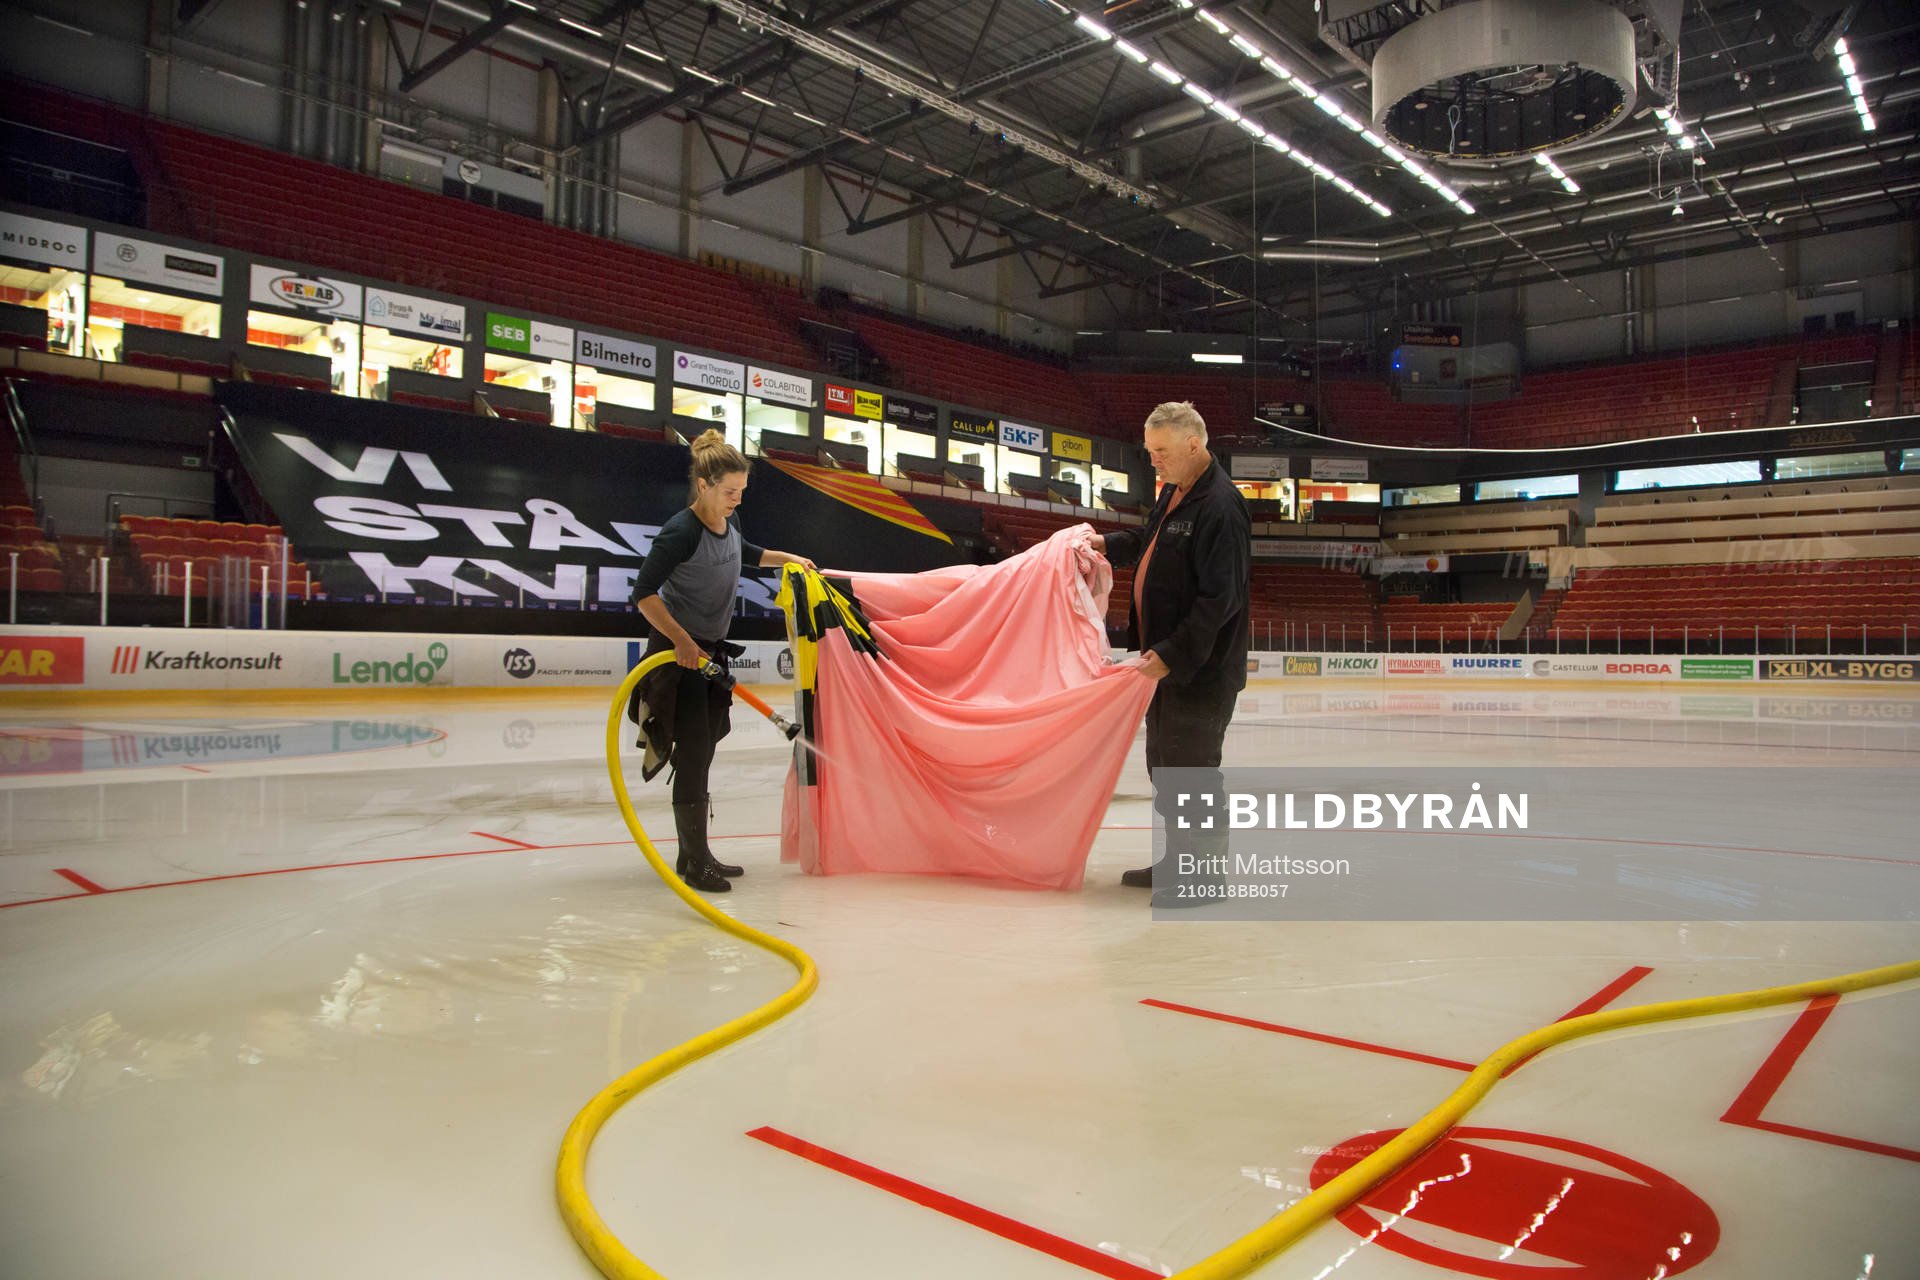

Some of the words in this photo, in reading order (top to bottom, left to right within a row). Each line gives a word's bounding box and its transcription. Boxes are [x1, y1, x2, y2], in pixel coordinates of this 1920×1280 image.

[3, 231, 77, 254] MIDROC
[281, 279, 335, 300] WEWAB
[492, 325, 526, 341] SEB
[582, 340, 652, 369] Bilmetro
[690, 361, 709, 370] Grant
[763, 377, 807, 395] COLABITOIL
[953, 420, 972, 432] CALL
[975, 425, 985, 433] UP
[1003, 427, 1039, 446] SKF
[1062, 438, 1083, 455] gibon
[272, 432, 453, 492] VI
[0, 648, 55, 676] AR
[145, 651, 282, 670] Kraftkonsult
[333, 653, 434, 684] Lendo
[506, 655, 532, 671] ISS
[1286, 657, 1318, 675] Cheers
[1328, 658, 1378, 669] HiKOKI
[1388, 659, 1441, 669] HYRMASKINER
[1453, 658, 1522, 668] HUURRE
[1606, 663, 1672, 674] BORGA
[1772, 663, 1805, 678] XL
[1810, 662, 1913, 678] XL-BYGG
